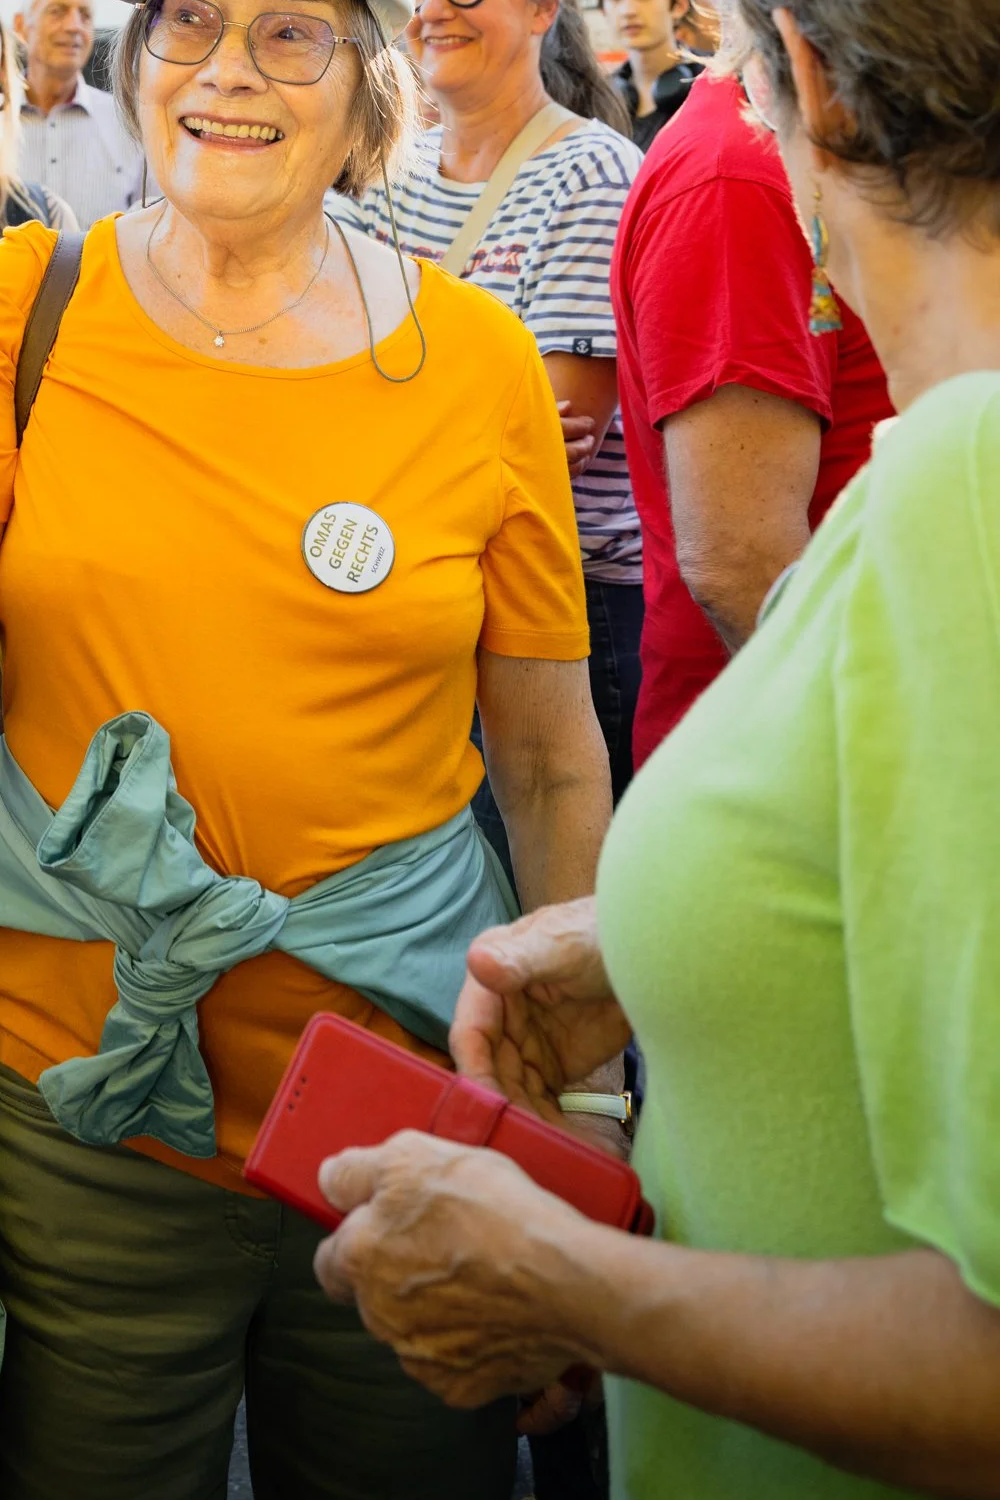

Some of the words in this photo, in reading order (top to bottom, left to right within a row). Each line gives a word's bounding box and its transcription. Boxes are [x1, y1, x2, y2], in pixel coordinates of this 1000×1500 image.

[310, 512, 337, 558] OMAS
[329, 518, 358, 569] GEGEN
[346, 524, 379, 583] RECHTS
